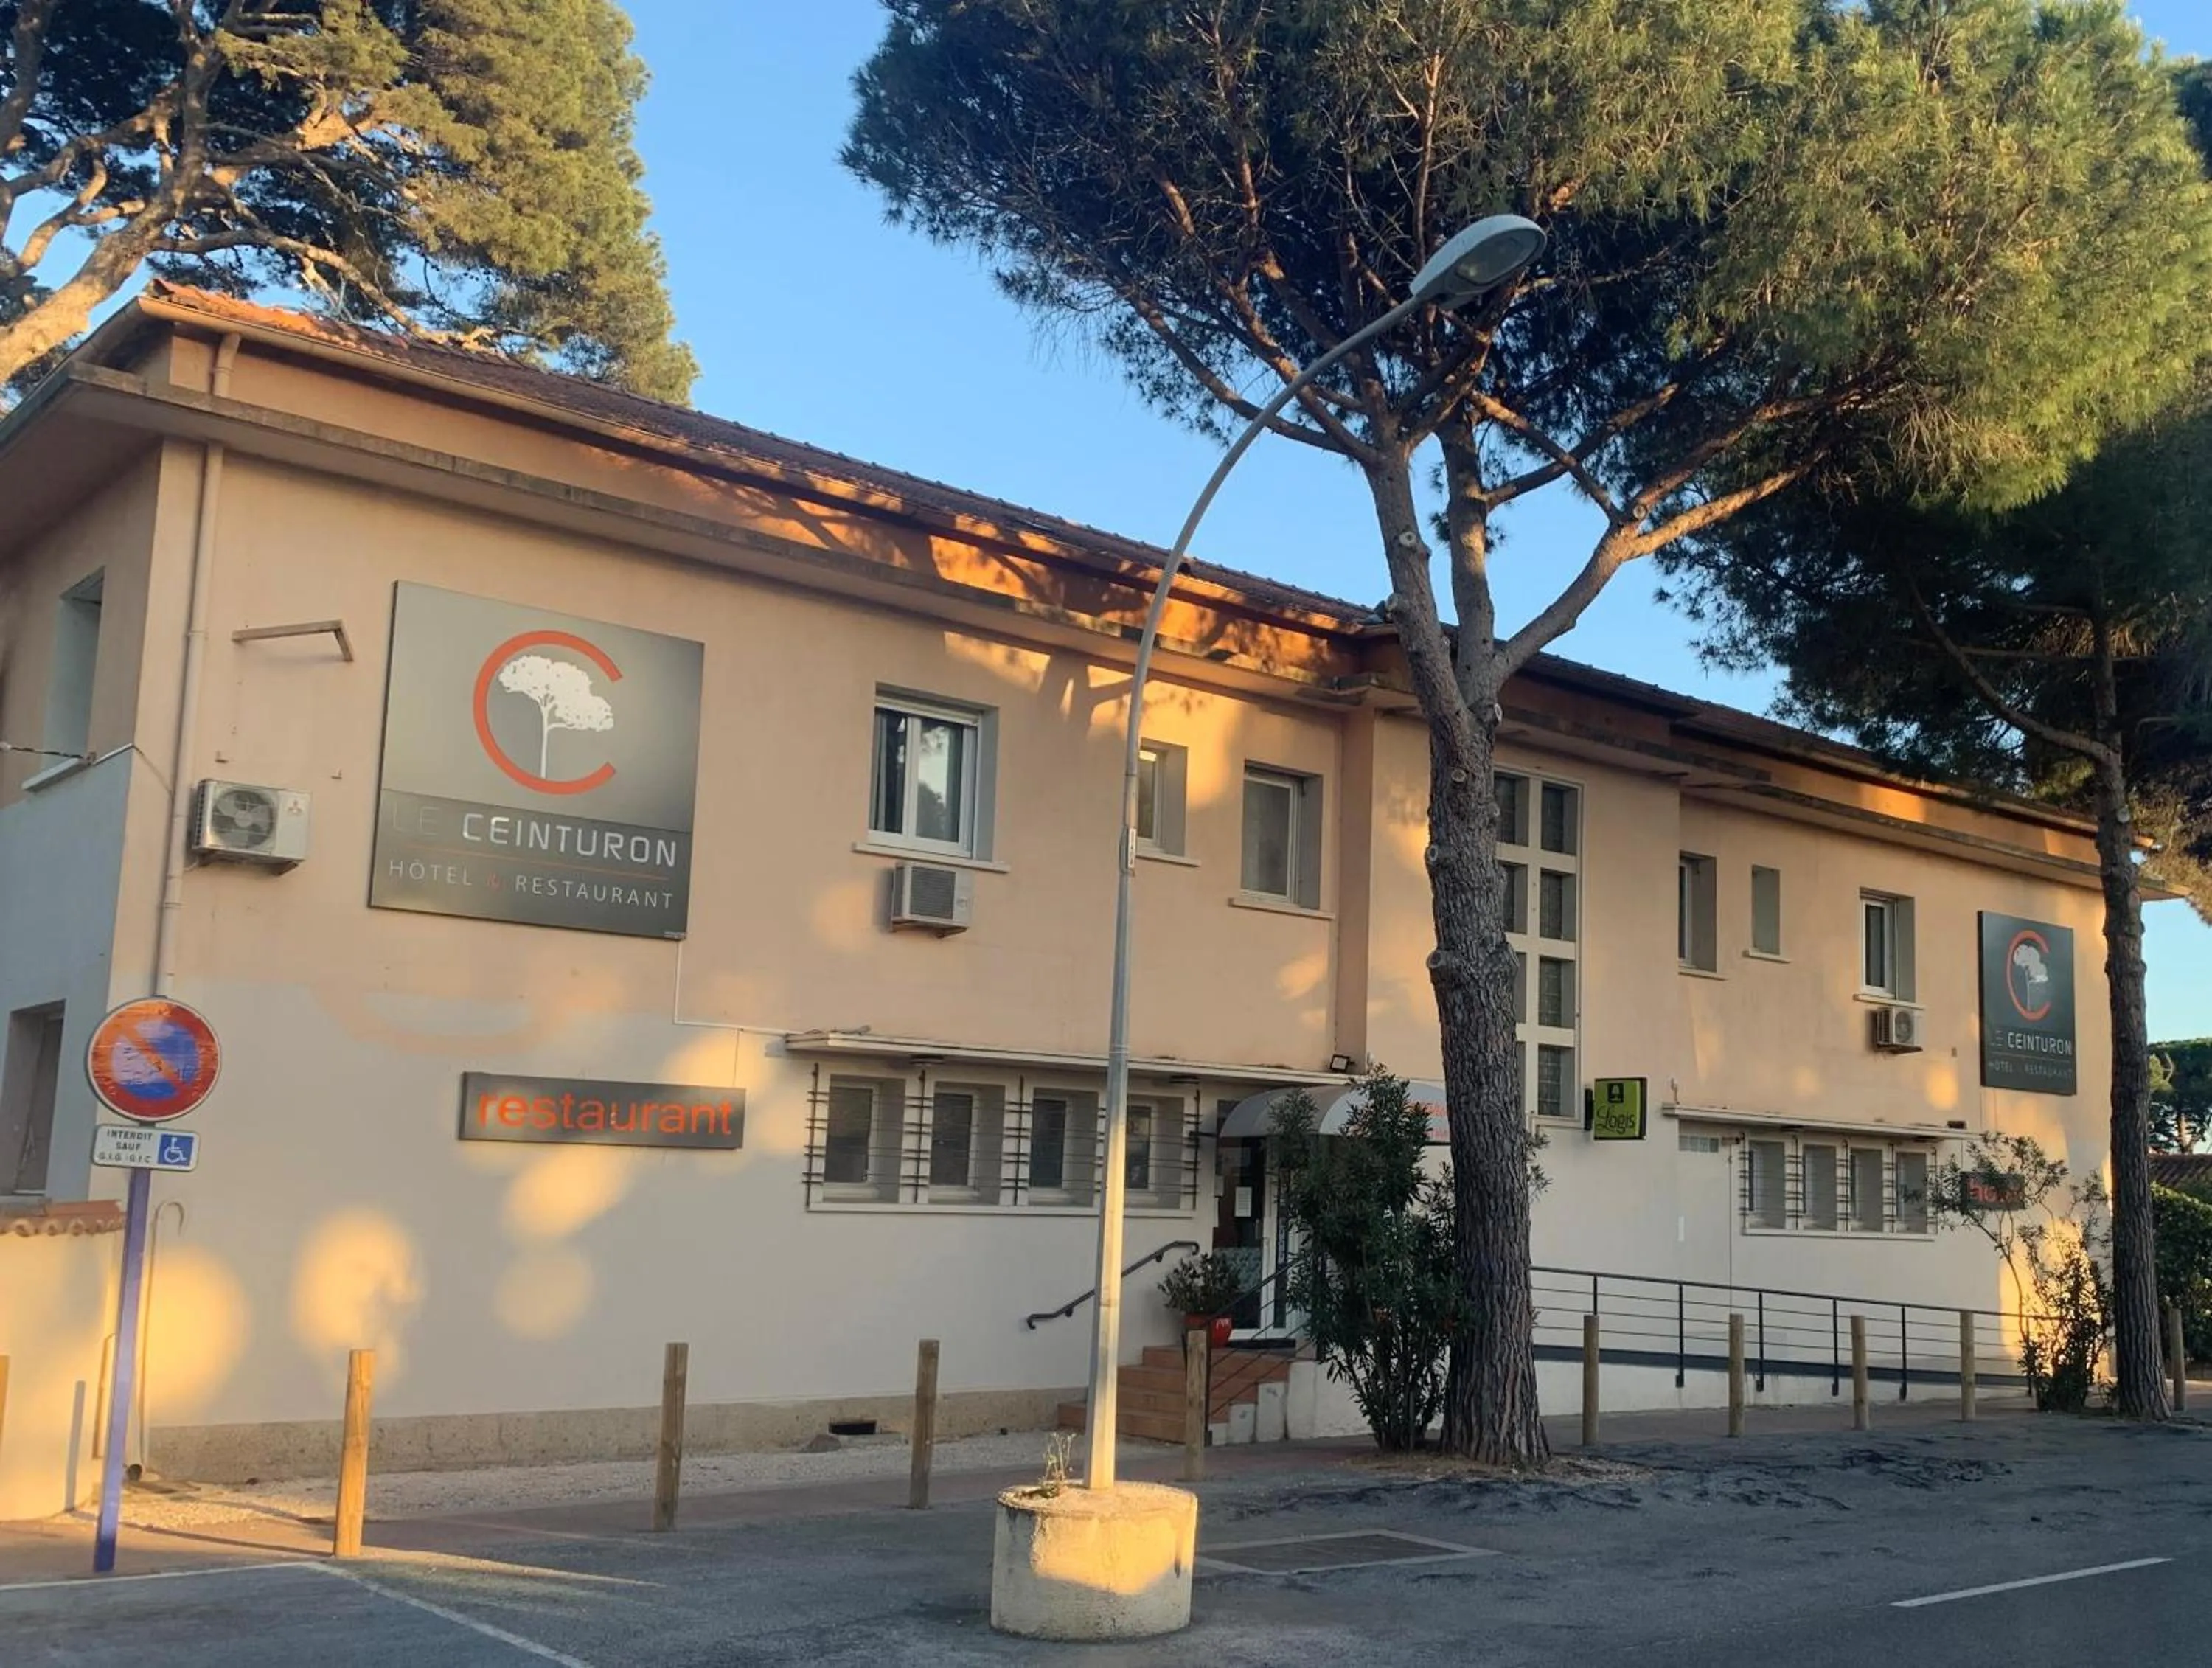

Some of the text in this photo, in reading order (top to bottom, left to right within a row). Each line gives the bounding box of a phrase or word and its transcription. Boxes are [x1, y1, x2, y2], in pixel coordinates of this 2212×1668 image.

[392, 802, 677, 867] LE CEINTURON
[389, 858, 473, 886] HÔTEL
[515, 875, 674, 909] RESTAURANT
[2008, 1032, 2073, 1056] CEINTURON
[478, 1091, 732, 1135] restaurant
[107, 1129, 153, 1141] INTERDIT
[116, 1142, 141, 1152] SAUF
